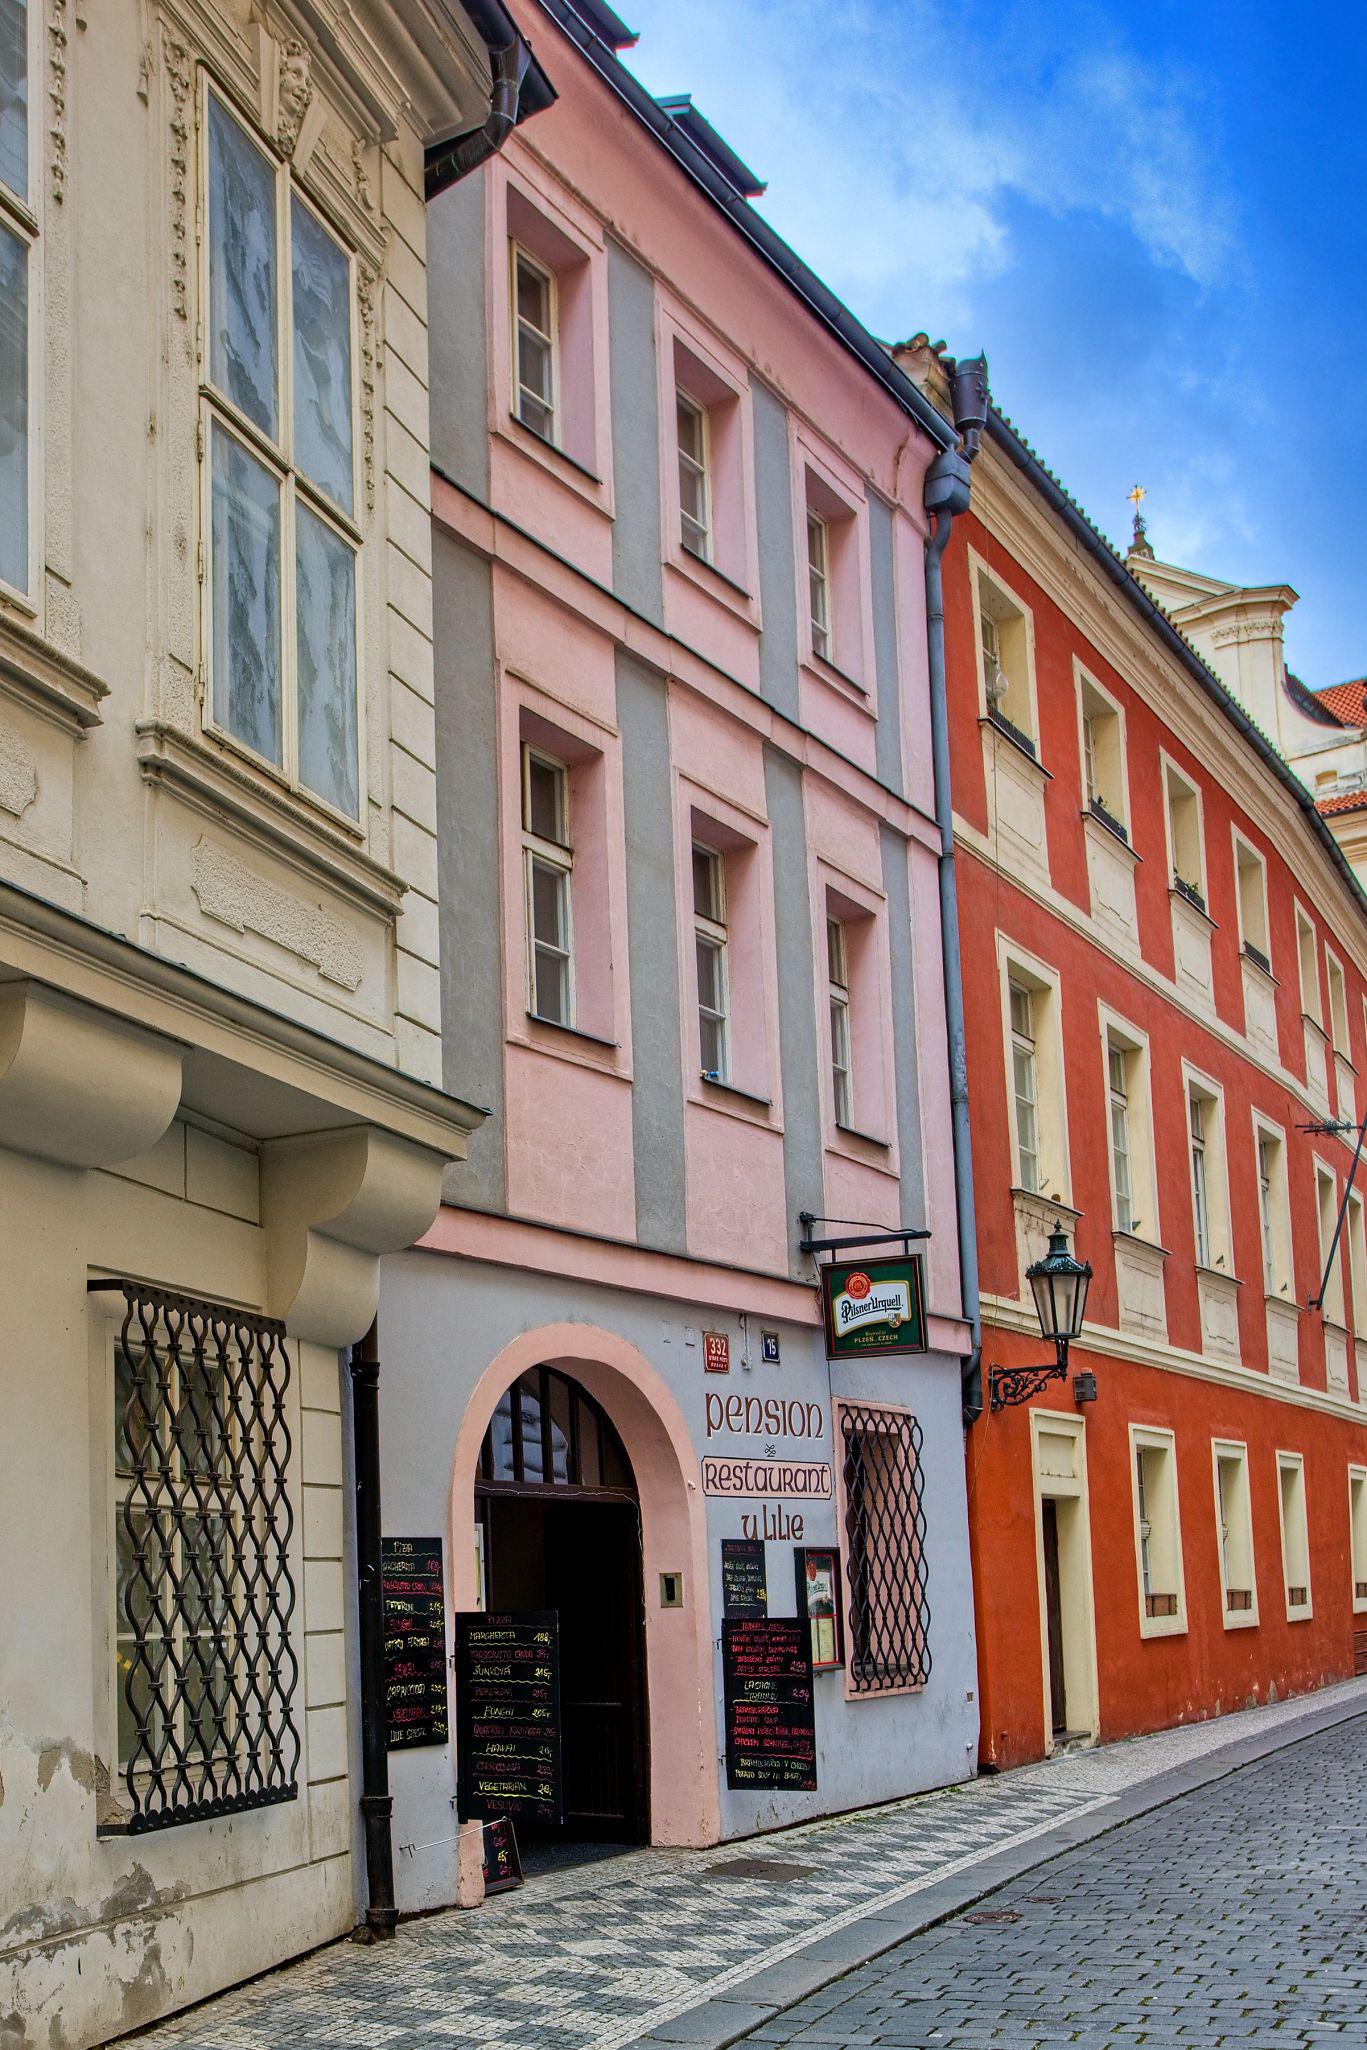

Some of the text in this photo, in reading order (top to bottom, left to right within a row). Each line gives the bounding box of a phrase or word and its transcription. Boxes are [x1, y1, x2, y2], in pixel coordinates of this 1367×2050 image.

[841, 1295, 901, 1324] Pilsner Urquell
[709, 1337, 727, 1356] 332
[767, 1338, 777, 1356] 15
[469, 1631, 516, 1640] MARGHERITA
[484, 1705, 515, 1716] FUNGHI
[735, 1769, 756, 1778] POTATO
[479, 1781, 527, 1791] VEGETARIAN
